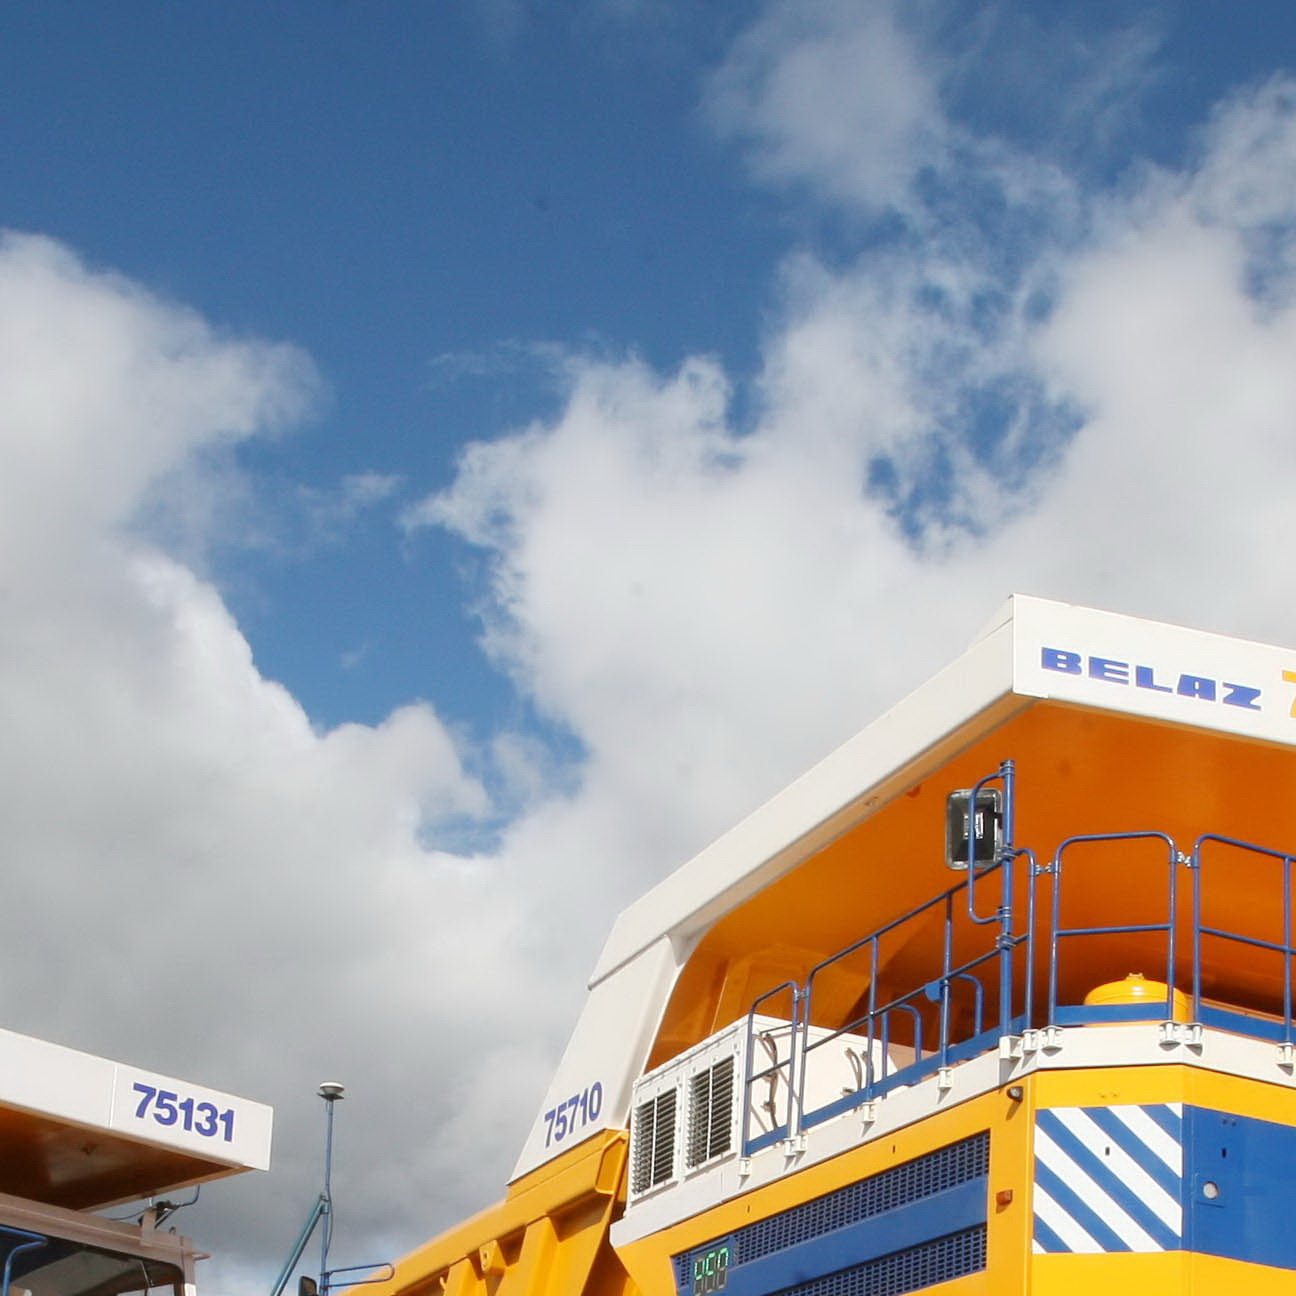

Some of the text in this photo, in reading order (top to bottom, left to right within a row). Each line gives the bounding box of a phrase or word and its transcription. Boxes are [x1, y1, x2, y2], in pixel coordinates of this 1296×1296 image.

[1040, 646, 1262, 711] BELAZ
[133, 1082, 235, 1143] 75131
[544, 1081, 603, 1148] 75710
